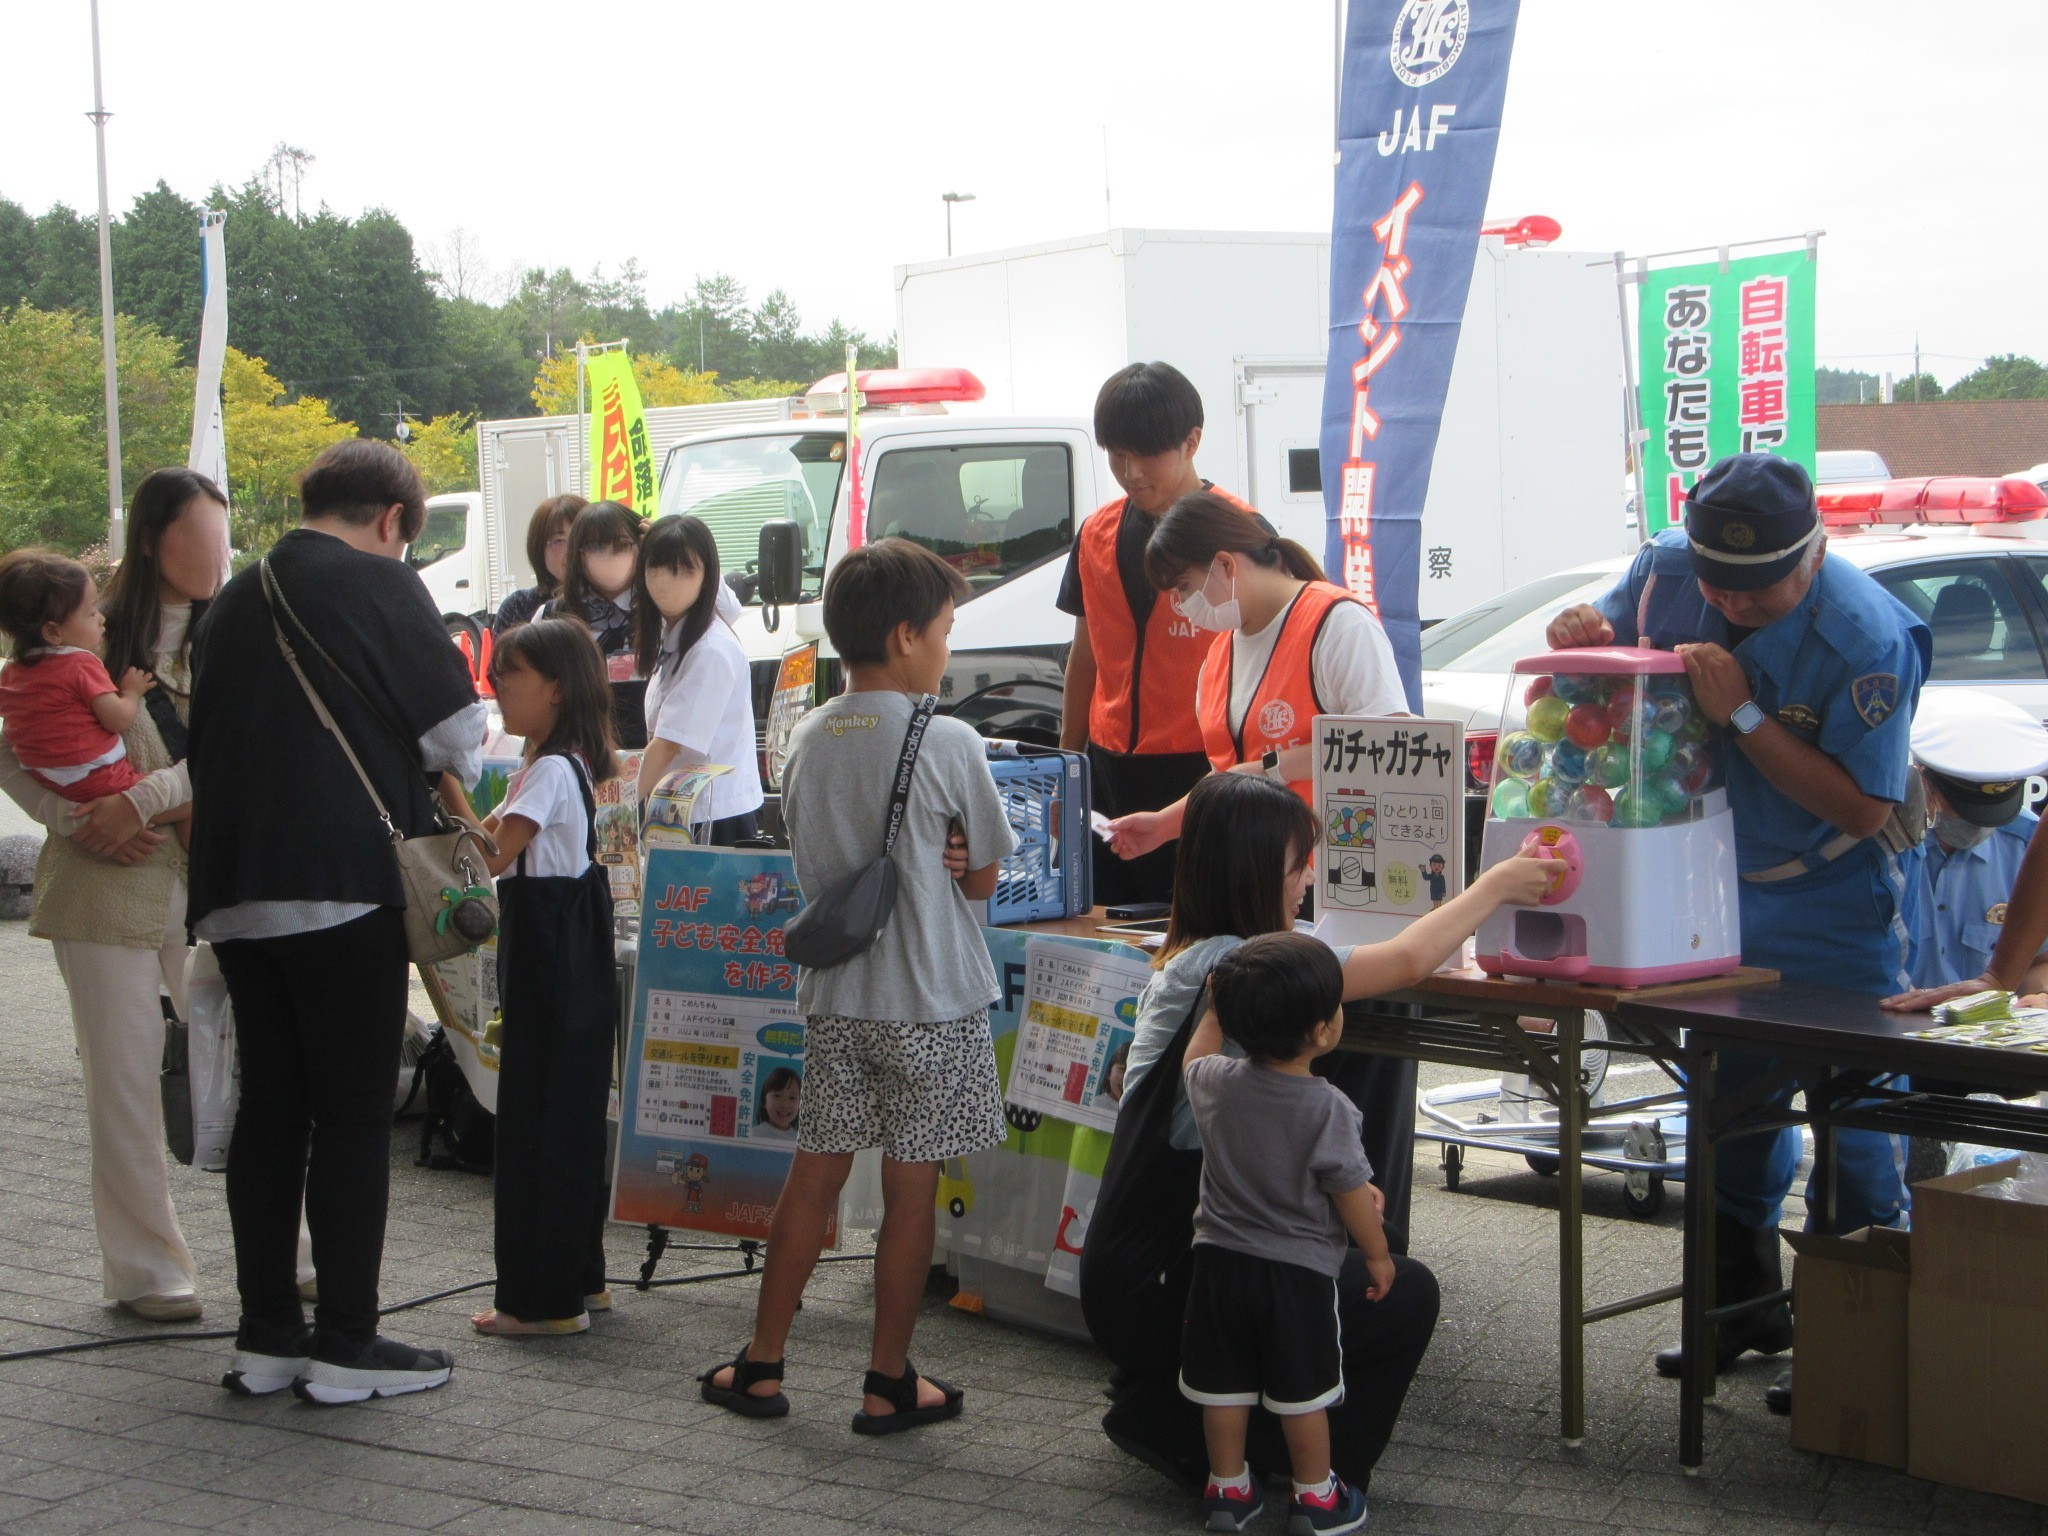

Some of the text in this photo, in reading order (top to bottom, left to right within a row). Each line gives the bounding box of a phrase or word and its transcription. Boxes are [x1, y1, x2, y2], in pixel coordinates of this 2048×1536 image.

[1392, 13, 1418, 85] FEDERATION
[1425, 4, 1467, 81] AUTOMOBILE
[1377, 105, 1456, 156] JAF
[1428, 546, 1452, 579] 察
[1169, 621, 1200, 638] JAF
[825, 713, 880, 737] Monkey
[1323, 728, 1452, 778] ガチャガチャ
[896, 763, 912, 794] new
[885, 802, 904, 855] alance
[1388, 874, 1408, 885] 無料
[656, 884, 711, 912] JAF
[723, 961, 800, 990] を作ろ
[737, 1052, 755, 1138] 安全免許証
